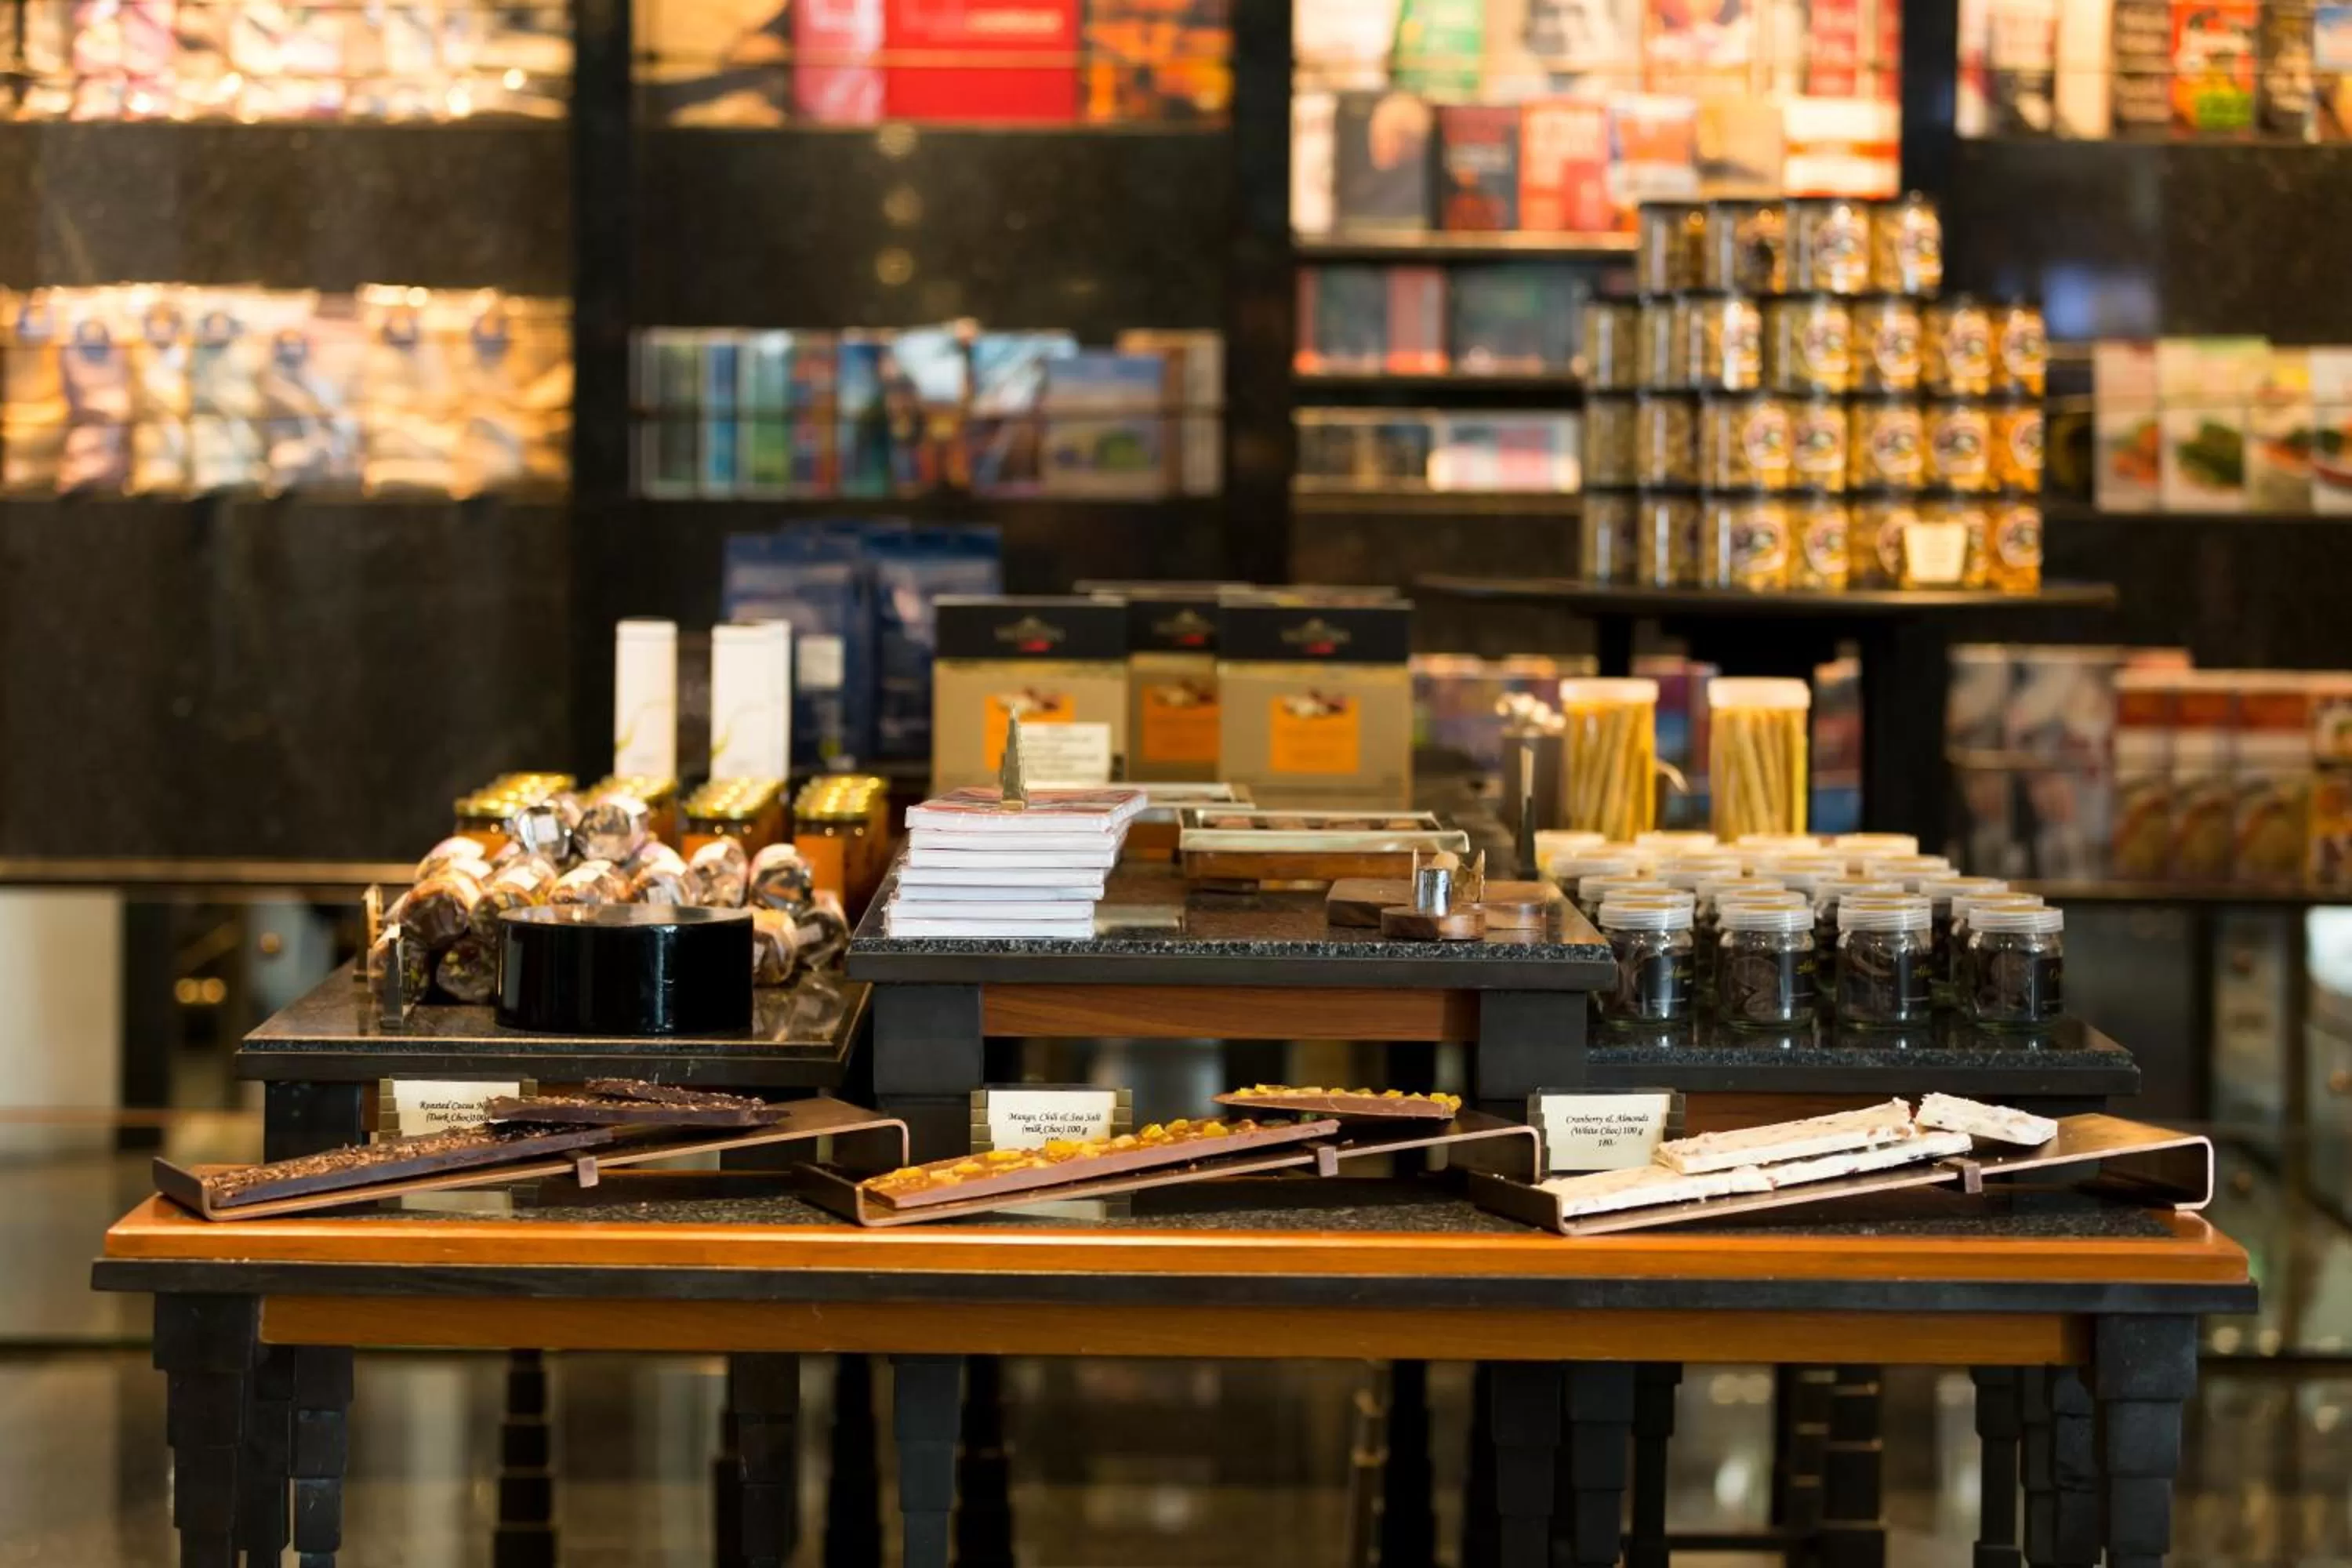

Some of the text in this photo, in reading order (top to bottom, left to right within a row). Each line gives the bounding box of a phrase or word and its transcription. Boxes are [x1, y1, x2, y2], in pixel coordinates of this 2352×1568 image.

[419, 1100, 452, 1110] Roasted
[1069, 1112, 1083, 1121] Sea
[1085, 1112, 1101, 1122] Salt
[1566, 1114, 1603, 1125] Cranberry
[1615, 1113, 1650, 1123] Almonds
[1081, 1127, 1087, 1135] g
[1570, 1126, 1644, 1138] (White Choc) 100 g
